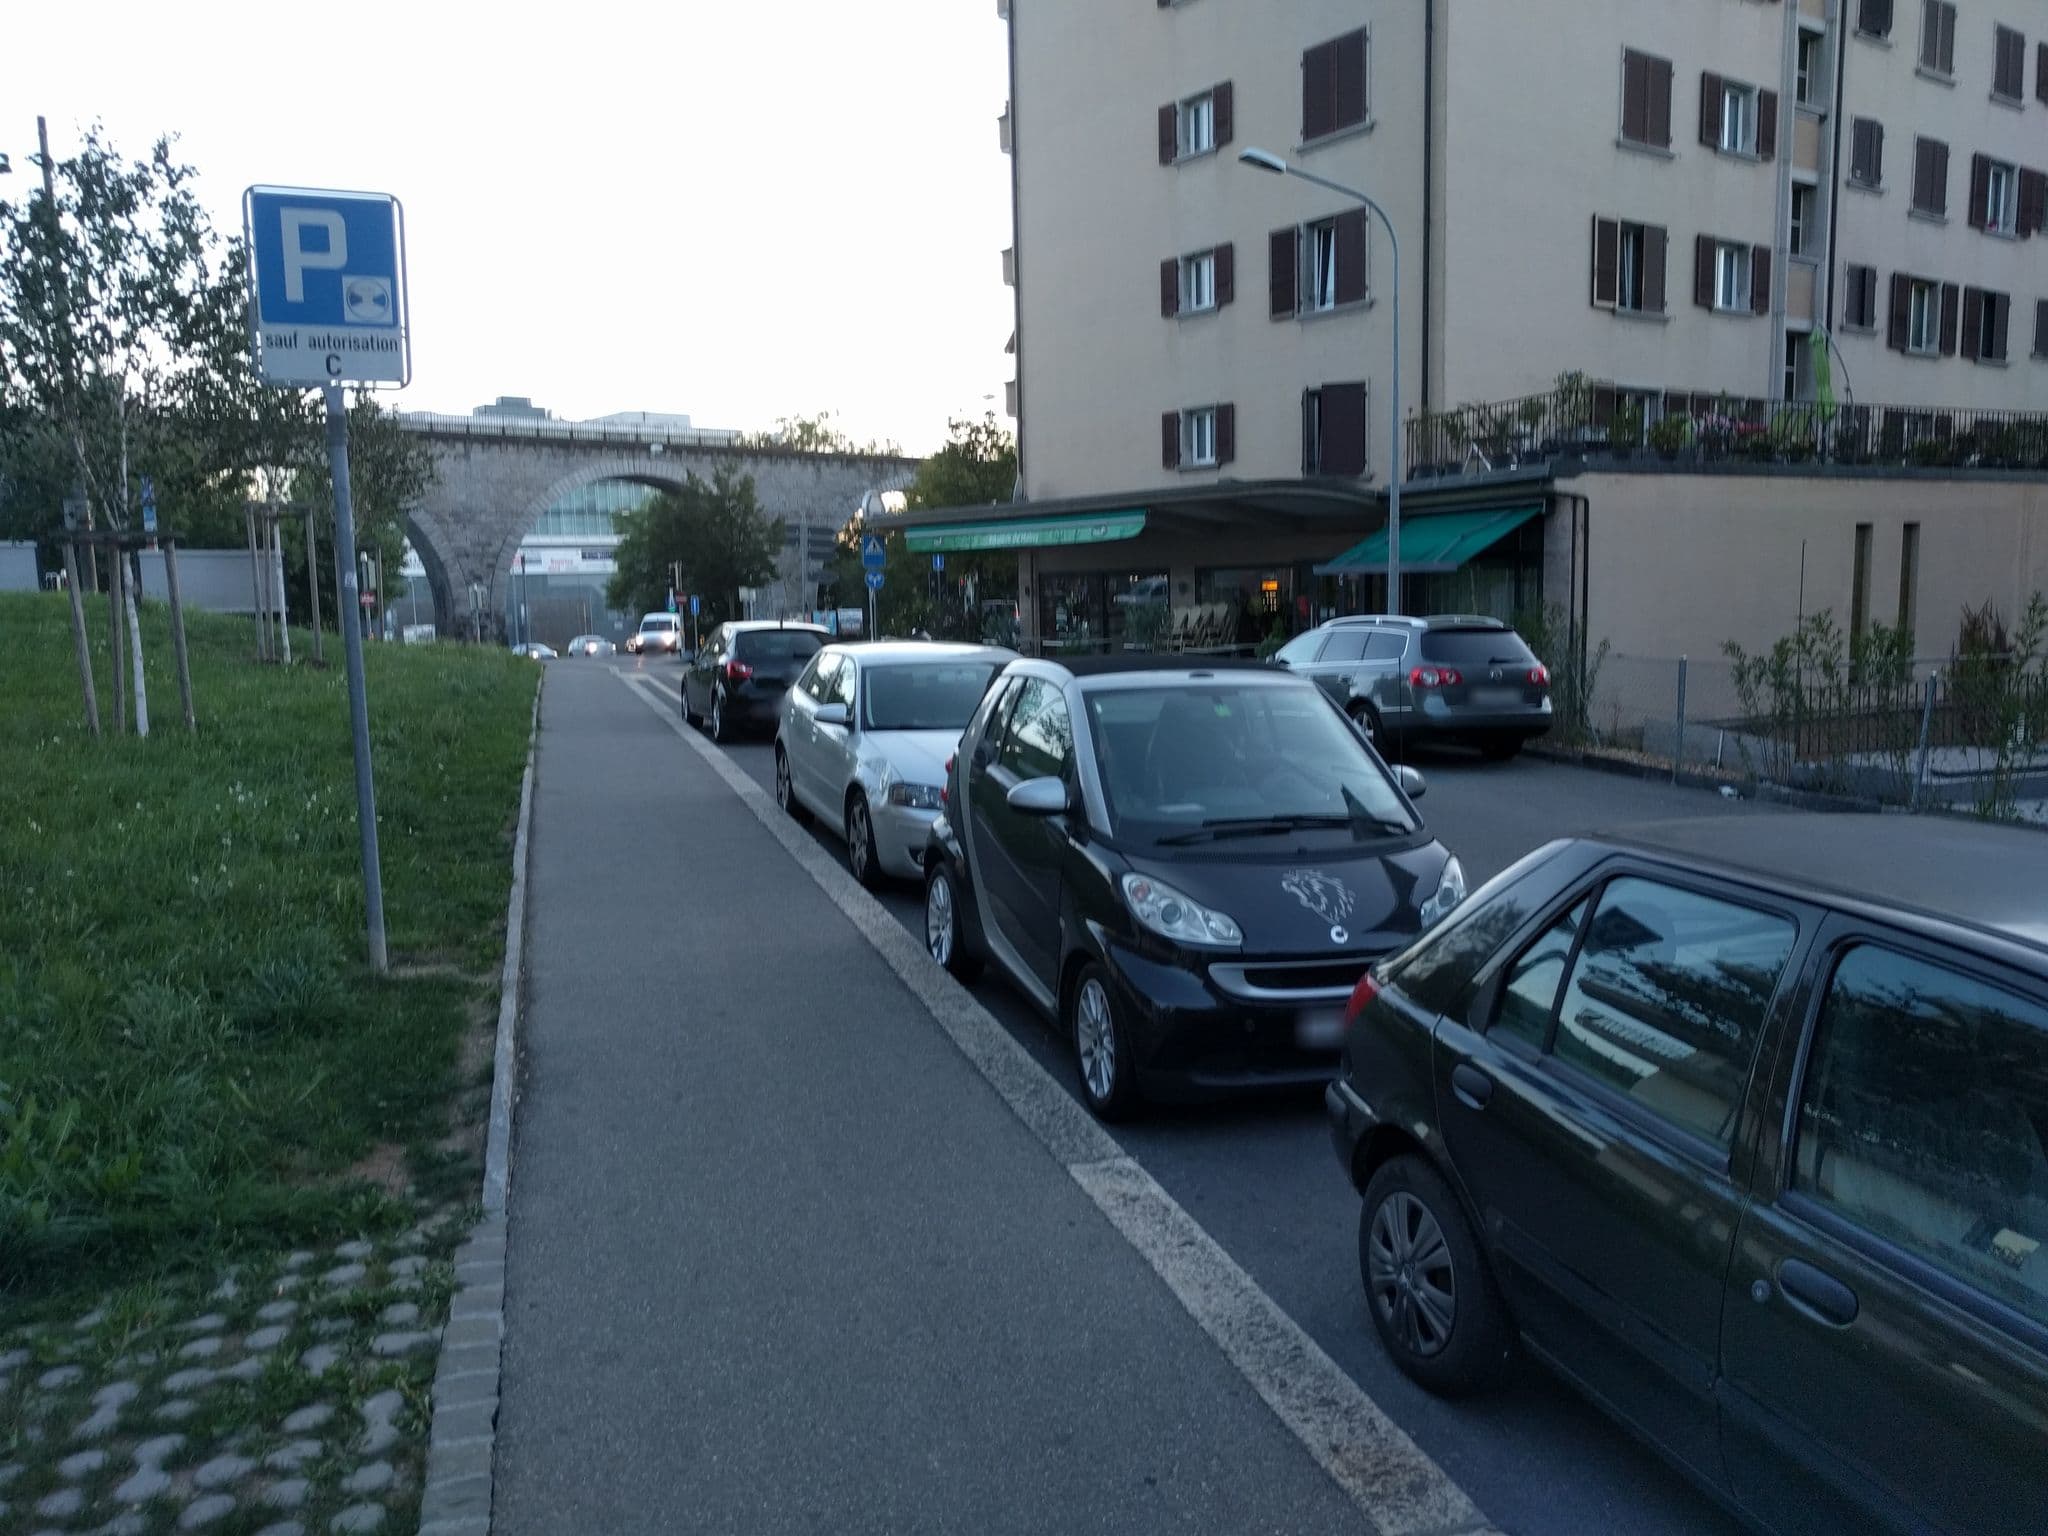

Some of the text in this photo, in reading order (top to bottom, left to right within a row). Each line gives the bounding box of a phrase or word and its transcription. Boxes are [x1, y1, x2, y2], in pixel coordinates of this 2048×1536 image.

[280, 206, 348, 304] P
[265, 330, 399, 352] sauf autorisation
[325, 353, 343, 377] C
